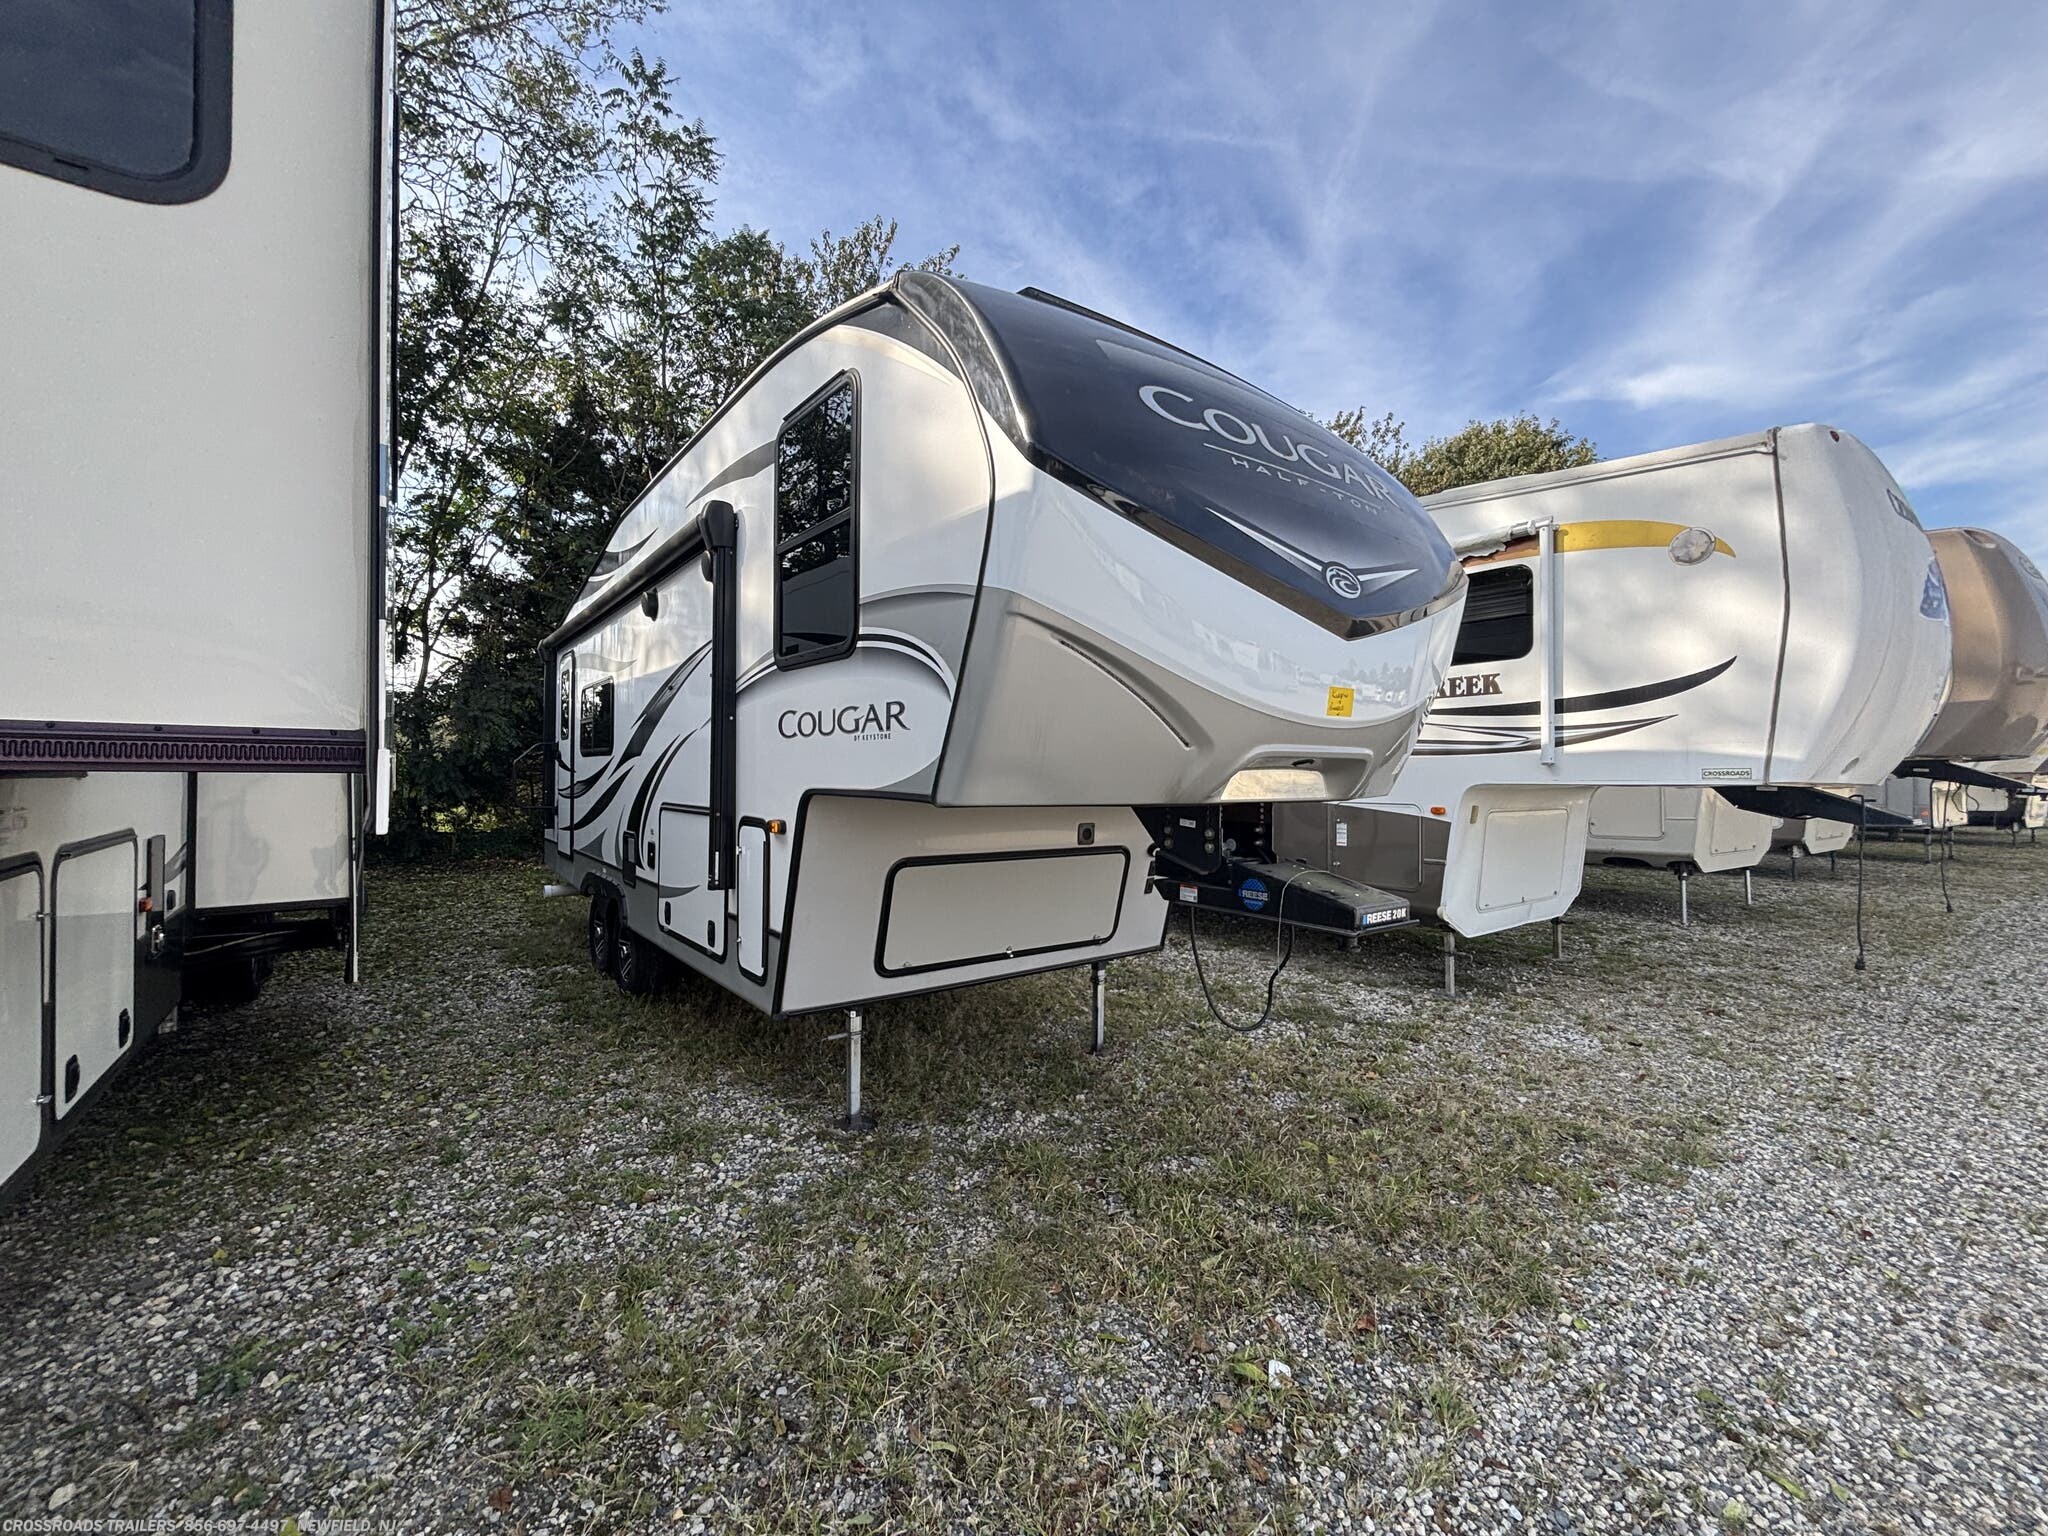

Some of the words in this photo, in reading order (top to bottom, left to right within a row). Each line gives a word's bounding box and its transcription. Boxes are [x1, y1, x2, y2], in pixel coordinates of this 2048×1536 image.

[1139, 385, 1403, 510] COUGAR
[1231, 456, 1379, 516] HALF-TON
[778, 701, 911, 739] COUGAR
[862, 733, 891, 741] KEYSTONE
[1242, 889, 1268, 901] REESE
[1366, 910, 1392, 924] REESE
[1392, 907, 1407, 920] 20K
